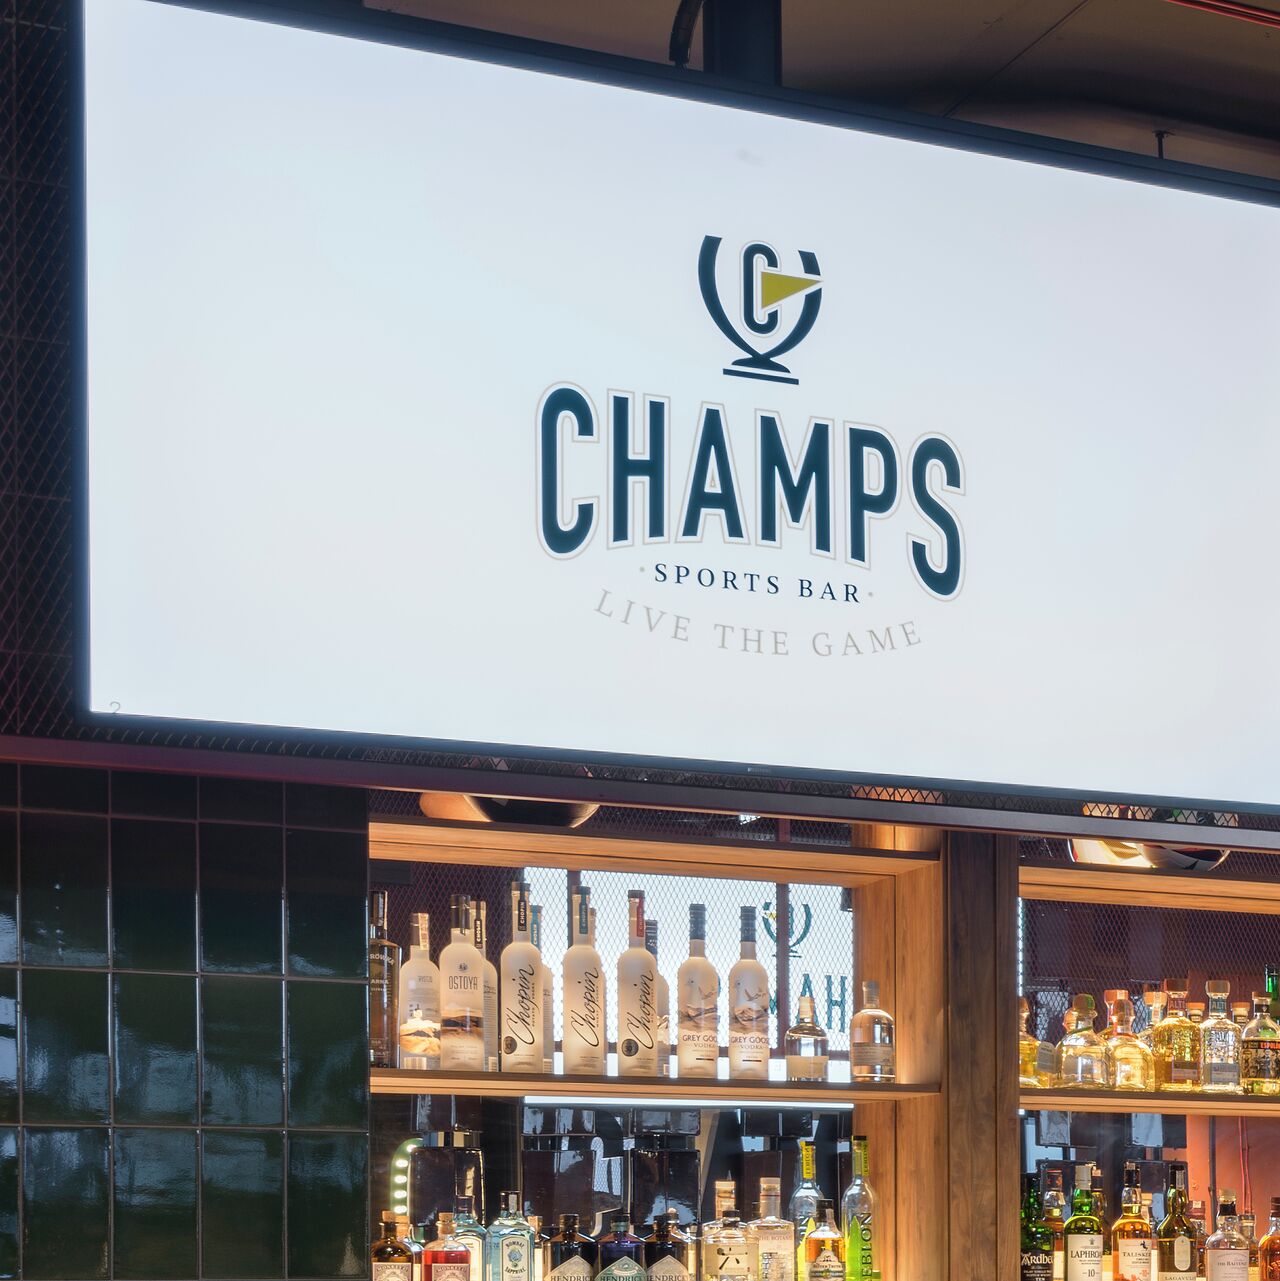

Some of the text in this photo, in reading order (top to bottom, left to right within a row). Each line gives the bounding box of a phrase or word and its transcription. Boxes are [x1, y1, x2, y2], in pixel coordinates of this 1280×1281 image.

[540, 386, 963, 597] CHAMPS
[654, 562, 861, 603] SPORTS BAR
[592, 589, 922, 658] LIVE THE GAME
[448, 975, 478, 990] OSTOYA
[507, 963, 535, 1045] Chopin
[571, 967, 600, 1048] Chopin
[626, 970, 655, 1050] Chopin
[682, 1034, 701, 1043] GREY
[1087, 1268, 1095, 1278] 10
